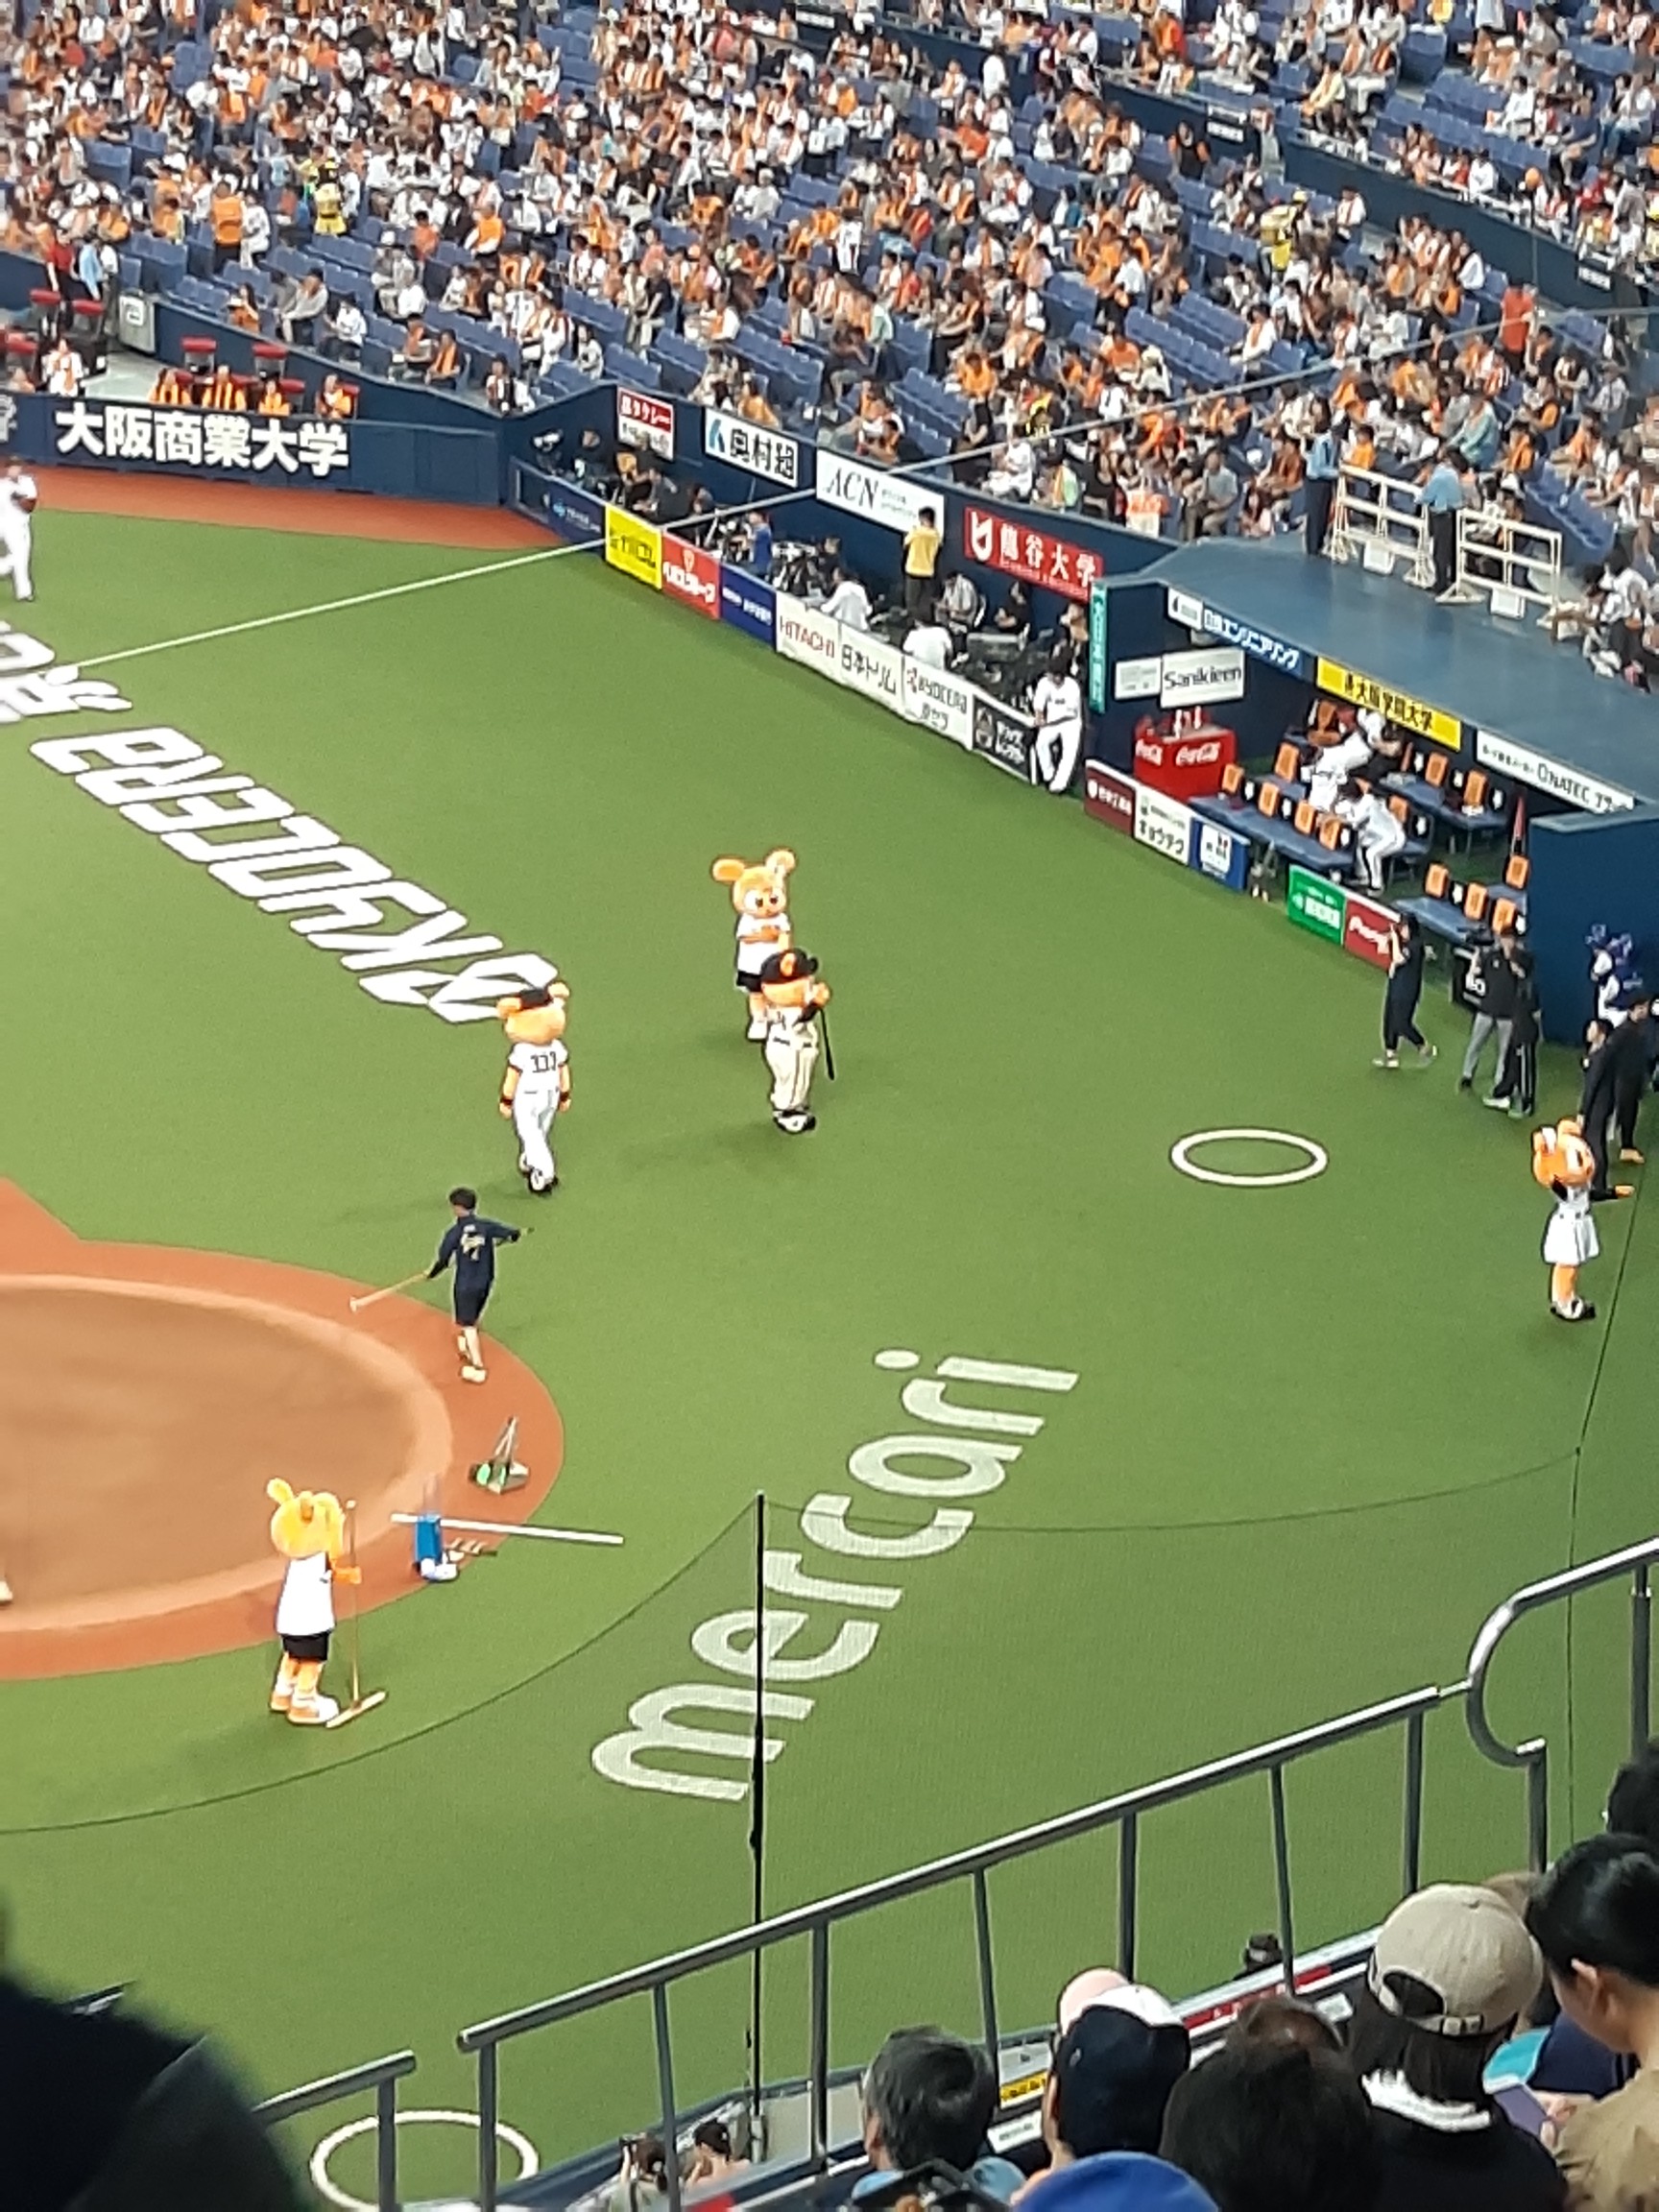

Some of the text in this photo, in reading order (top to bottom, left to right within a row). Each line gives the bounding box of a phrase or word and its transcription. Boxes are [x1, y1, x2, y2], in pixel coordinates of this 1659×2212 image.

[55, 401, 349, 477] 大阪商業大学
[825, 467, 879, 510] ACN
[999, 522, 1096, 588] 龍谷大学
[780, 614, 835, 659] HITACHI
[589, 1348, 1080, 1803] mercari
